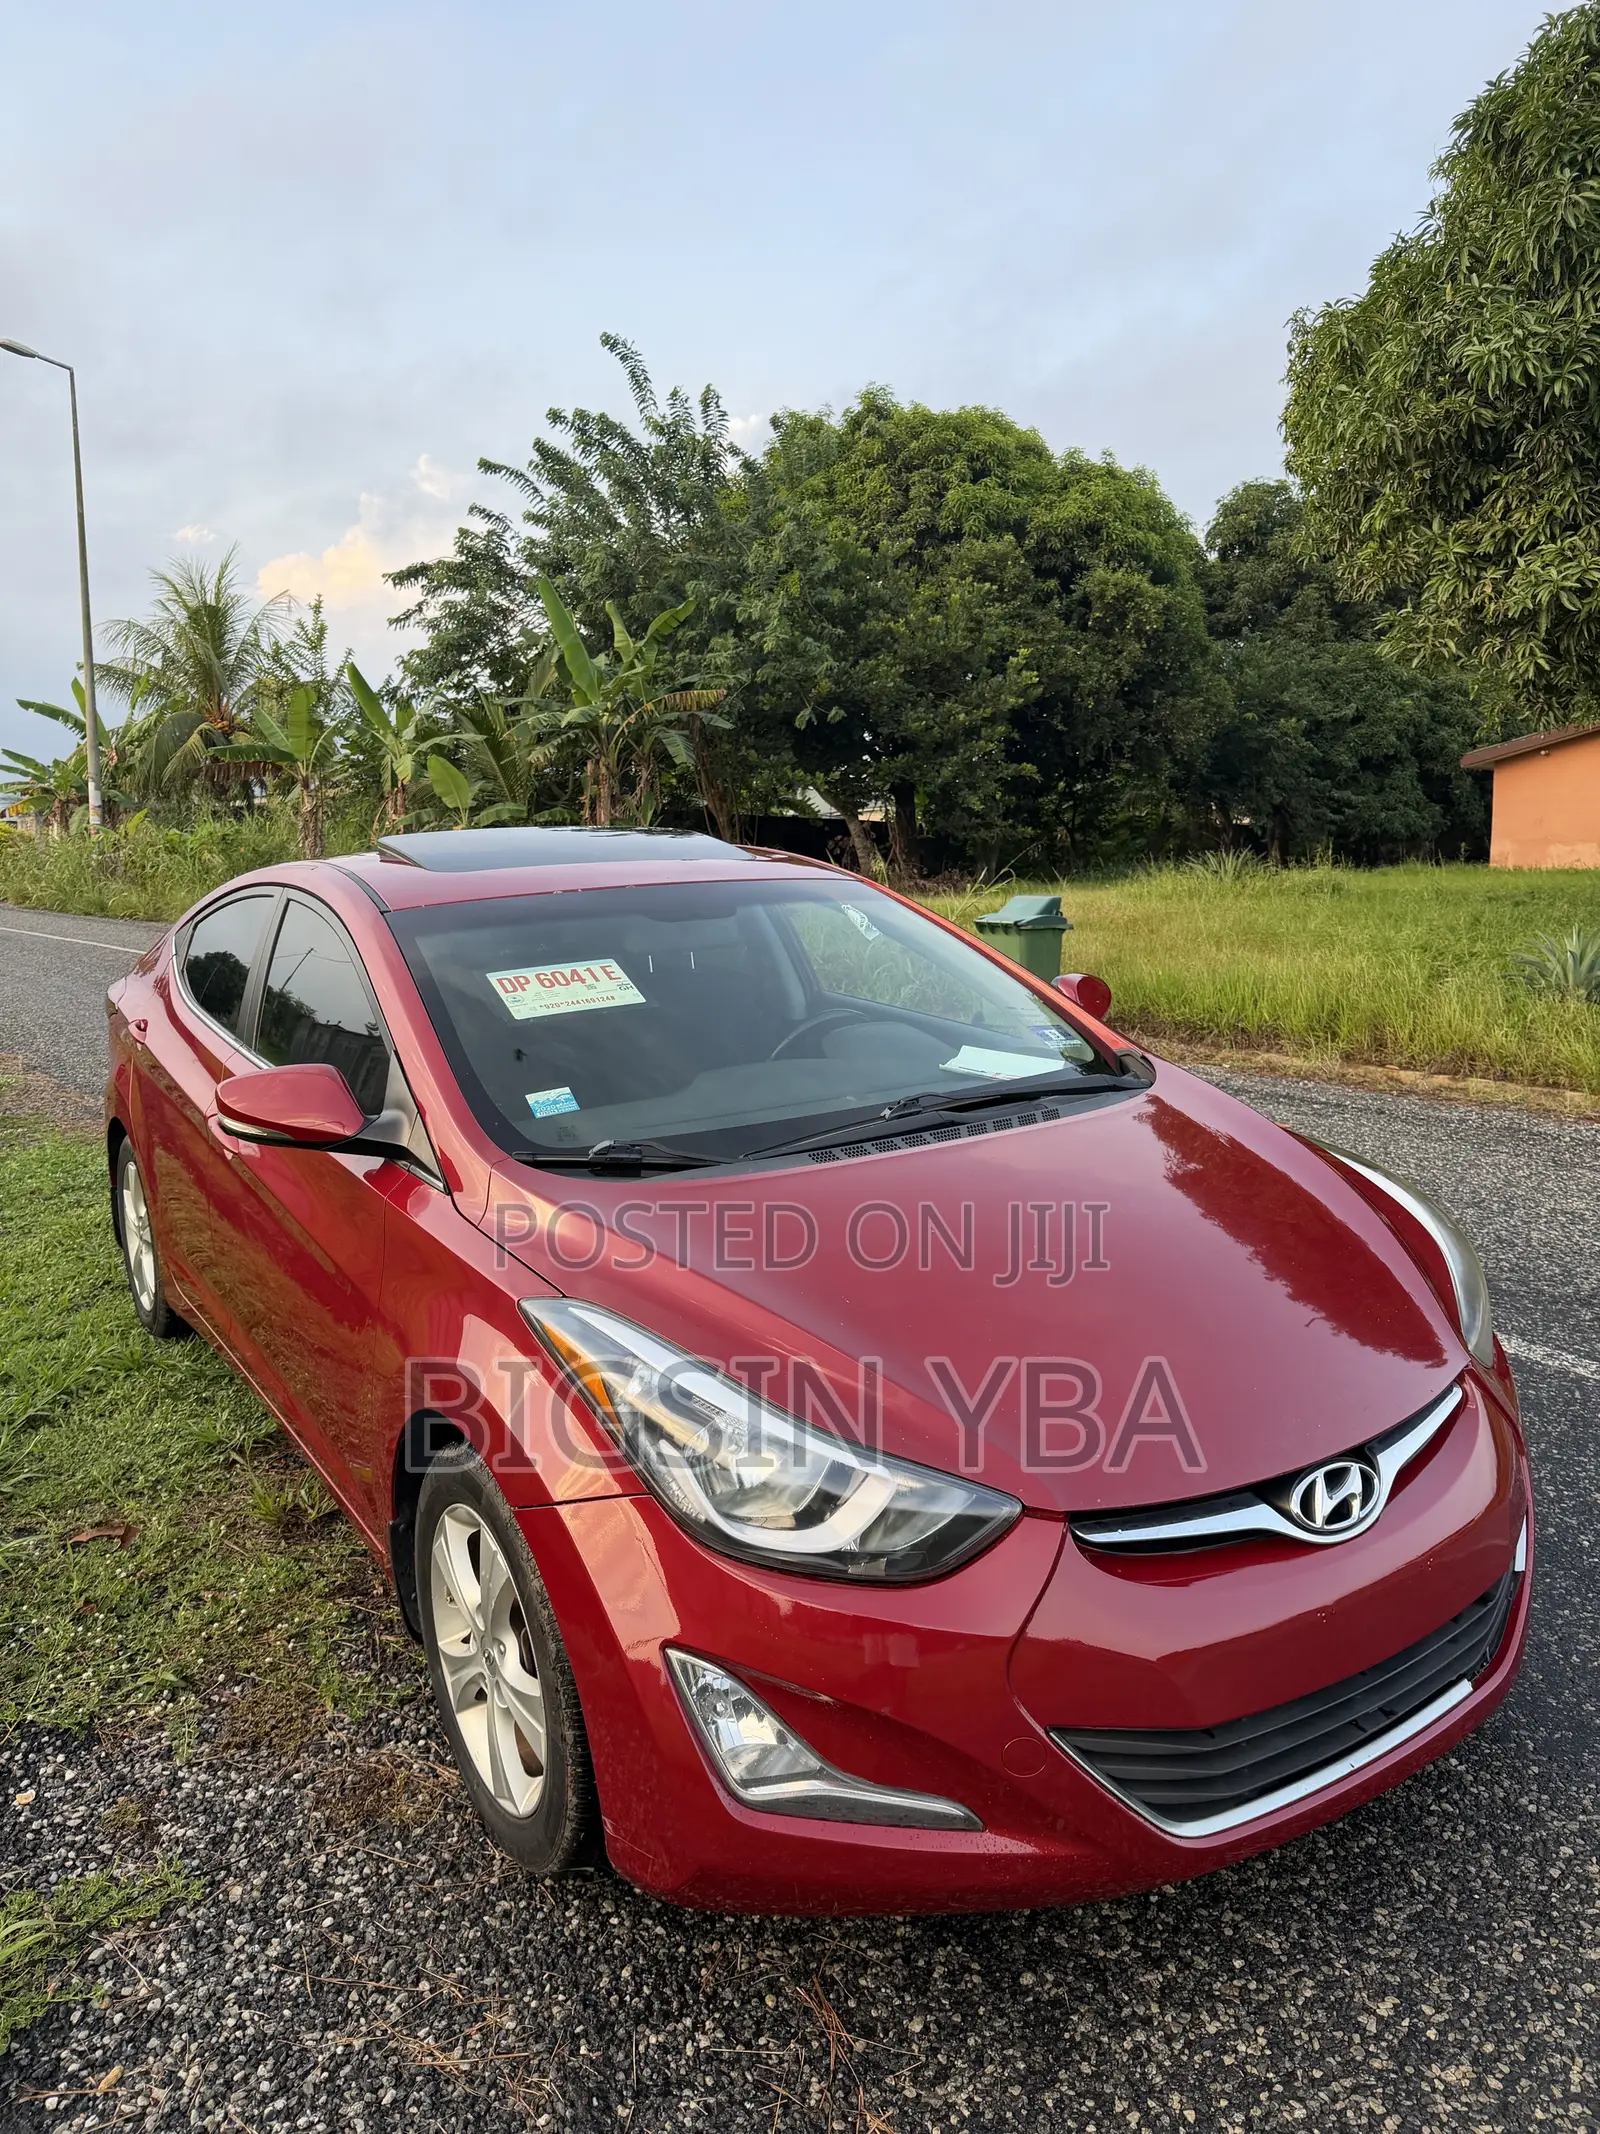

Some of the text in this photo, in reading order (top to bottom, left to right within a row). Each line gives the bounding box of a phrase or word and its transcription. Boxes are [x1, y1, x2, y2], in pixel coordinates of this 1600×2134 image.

[496, 975, 531, 994] DP
[535, 968, 600, 989] 6041
[600, 965, 622, 981] E
